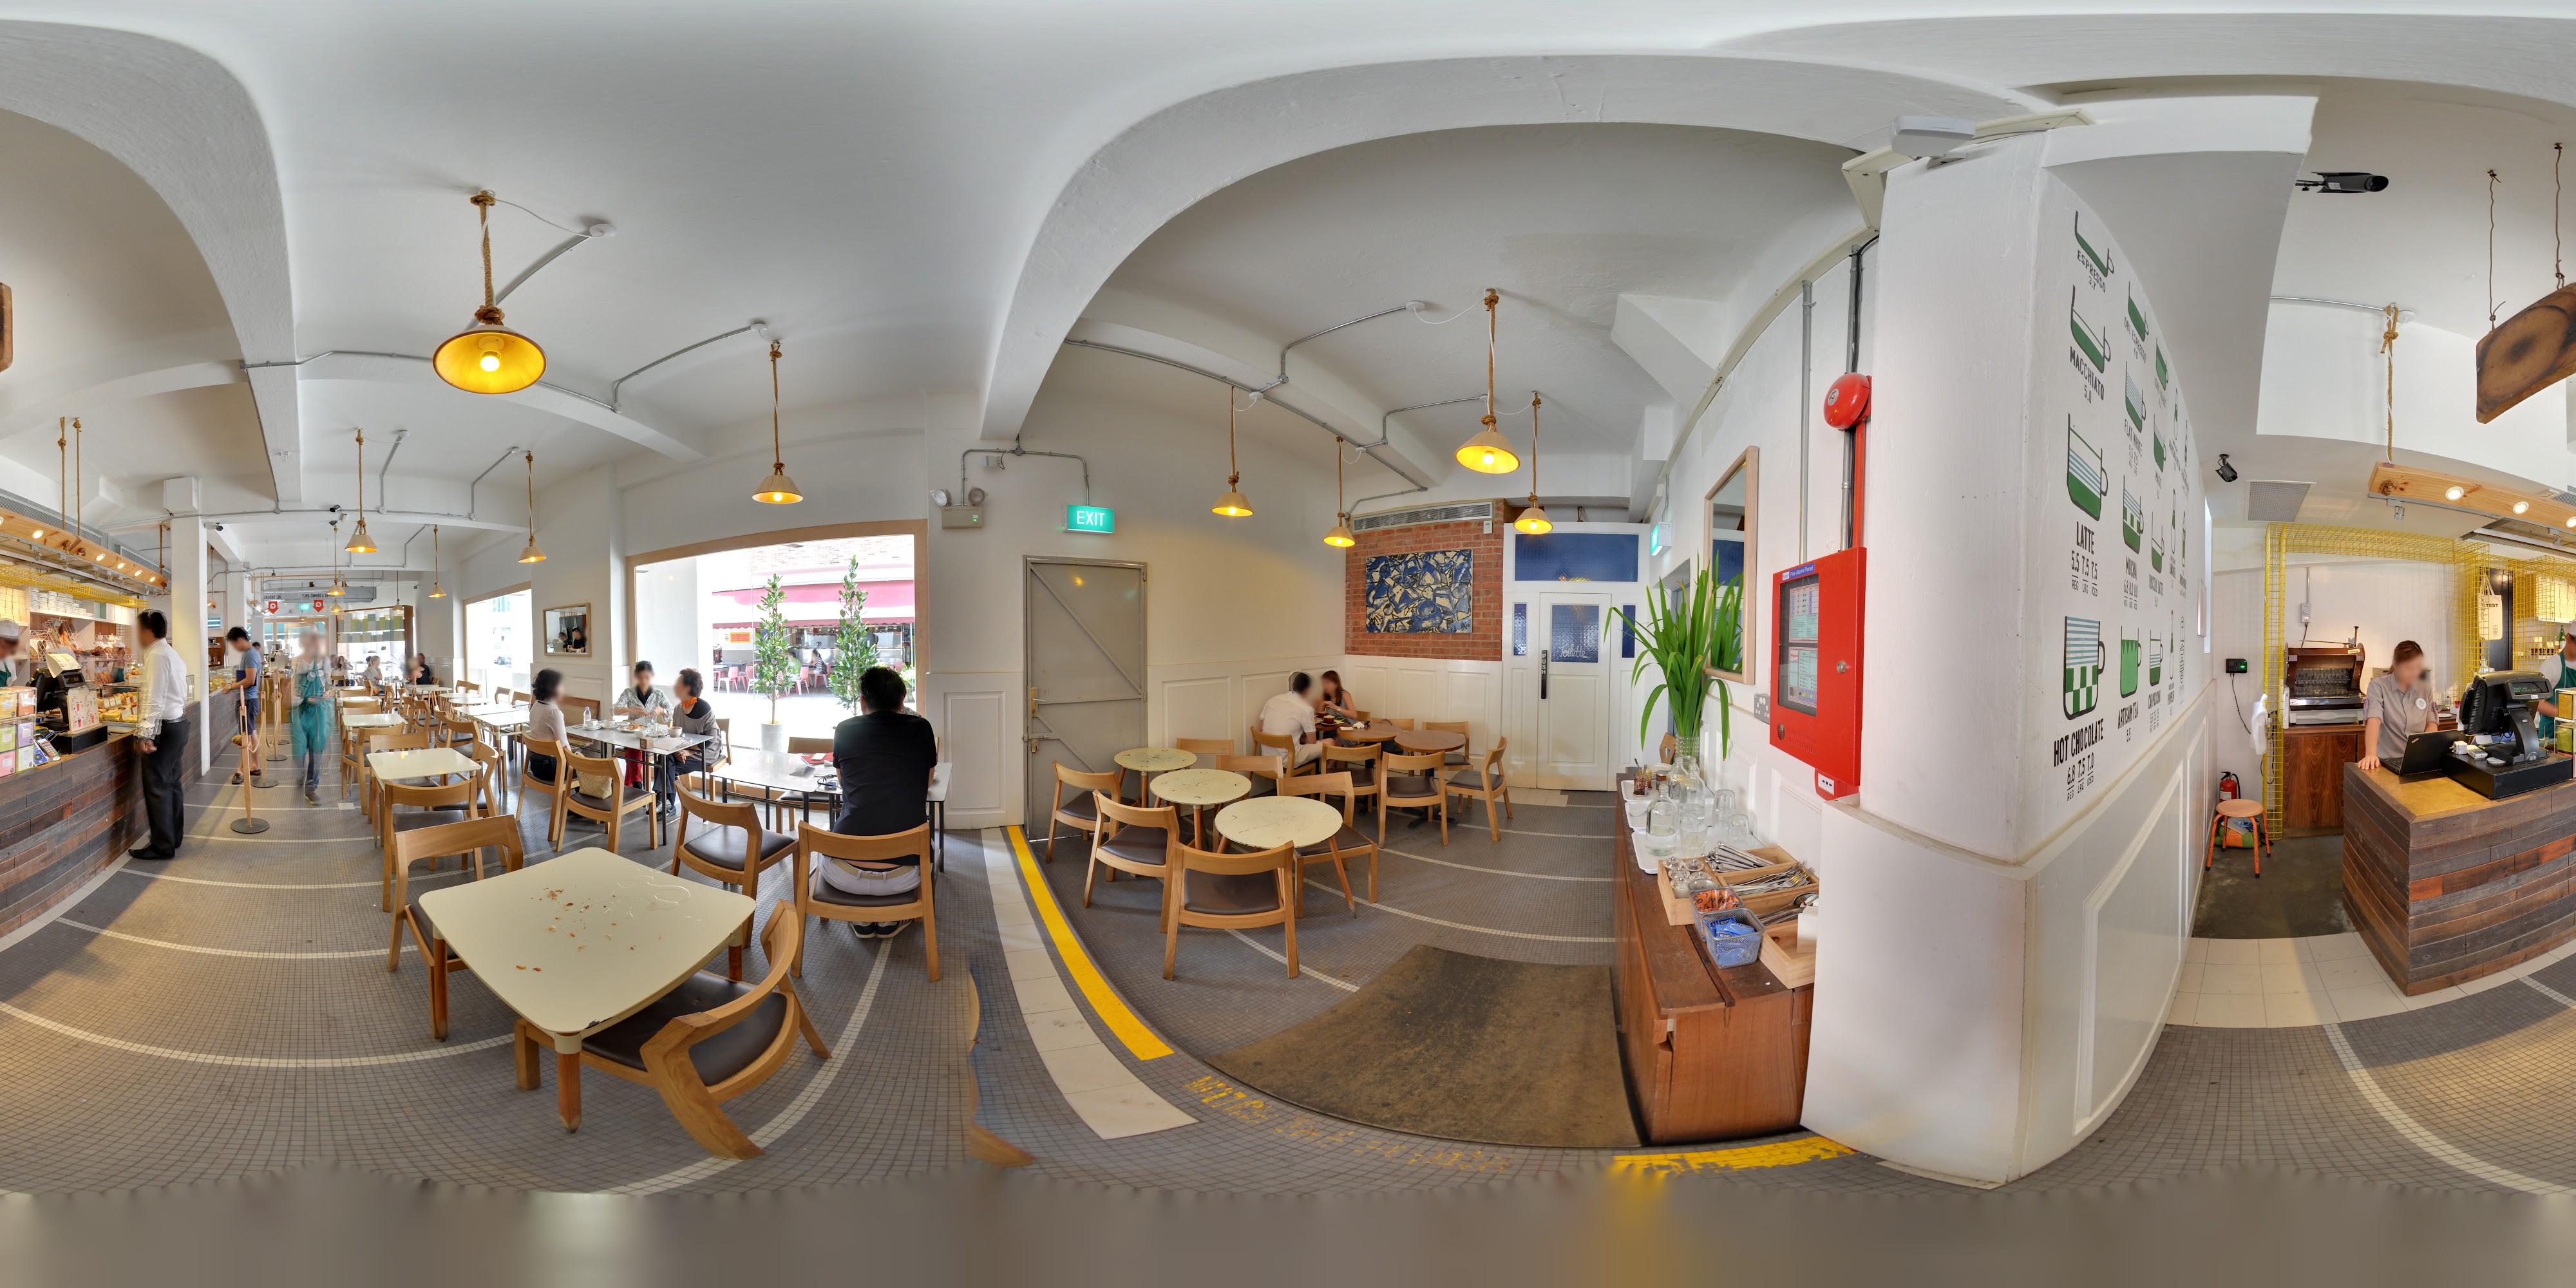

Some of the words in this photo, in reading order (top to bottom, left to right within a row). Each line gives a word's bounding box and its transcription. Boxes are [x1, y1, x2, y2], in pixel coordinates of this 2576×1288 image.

[2077, 249, 2106, 293] ESPRESSO
[2132, 330, 2146, 364] ESPRESSO
[2070, 345, 2105, 401] MACCHIATO
[2124, 419, 2132, 442] FLAT
[2133, 431, 2142, 457] WHITE
[1076, 510, 1105, 526] EXIT
[2076, 521, 2094, 554] LATTE
[2071, 550, 2079, 573] 5.5
[2126, 556, 2137, 580] MOCHA
[1558, 643, 1586, 658] Toilette
[2117, 706, 2133, 730] ARTISAN
[2054, 734, 2069, 768] HOT
[2070, 717, 2104, 757] CHOCOLATE
